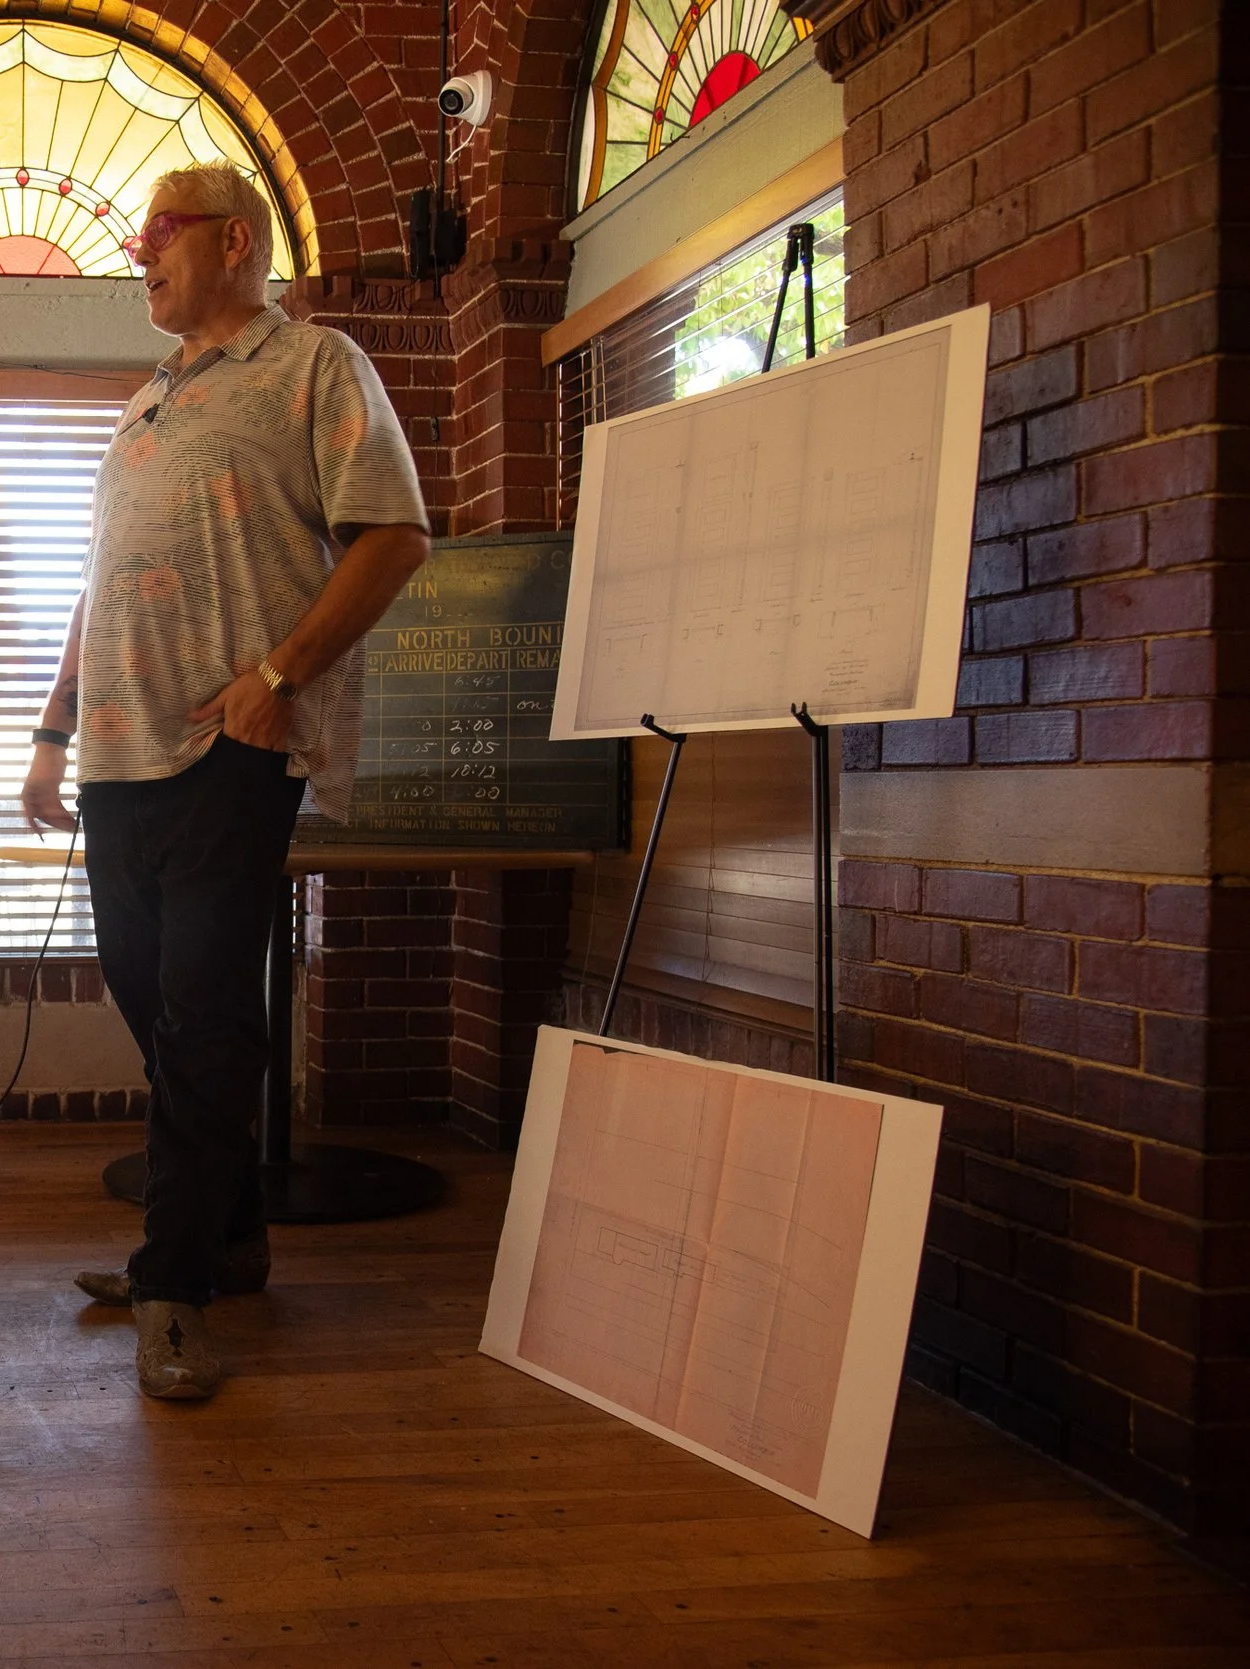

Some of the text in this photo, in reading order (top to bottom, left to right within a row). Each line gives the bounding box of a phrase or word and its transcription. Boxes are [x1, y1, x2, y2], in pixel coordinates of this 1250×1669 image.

[397, 630, 470, 650] NORTH
[385, 652, 443, 672] ARRIVE
[447, 651, 507, 671] DEPART
[450, 719, 494, 733] 2:00
[450, 740, 500, 755] 6:05
[443, 806, 497, 818] GENERAL
[370, 819, 450, 831] INFORMATION
[458, 820, 500, 832] SHOWN
